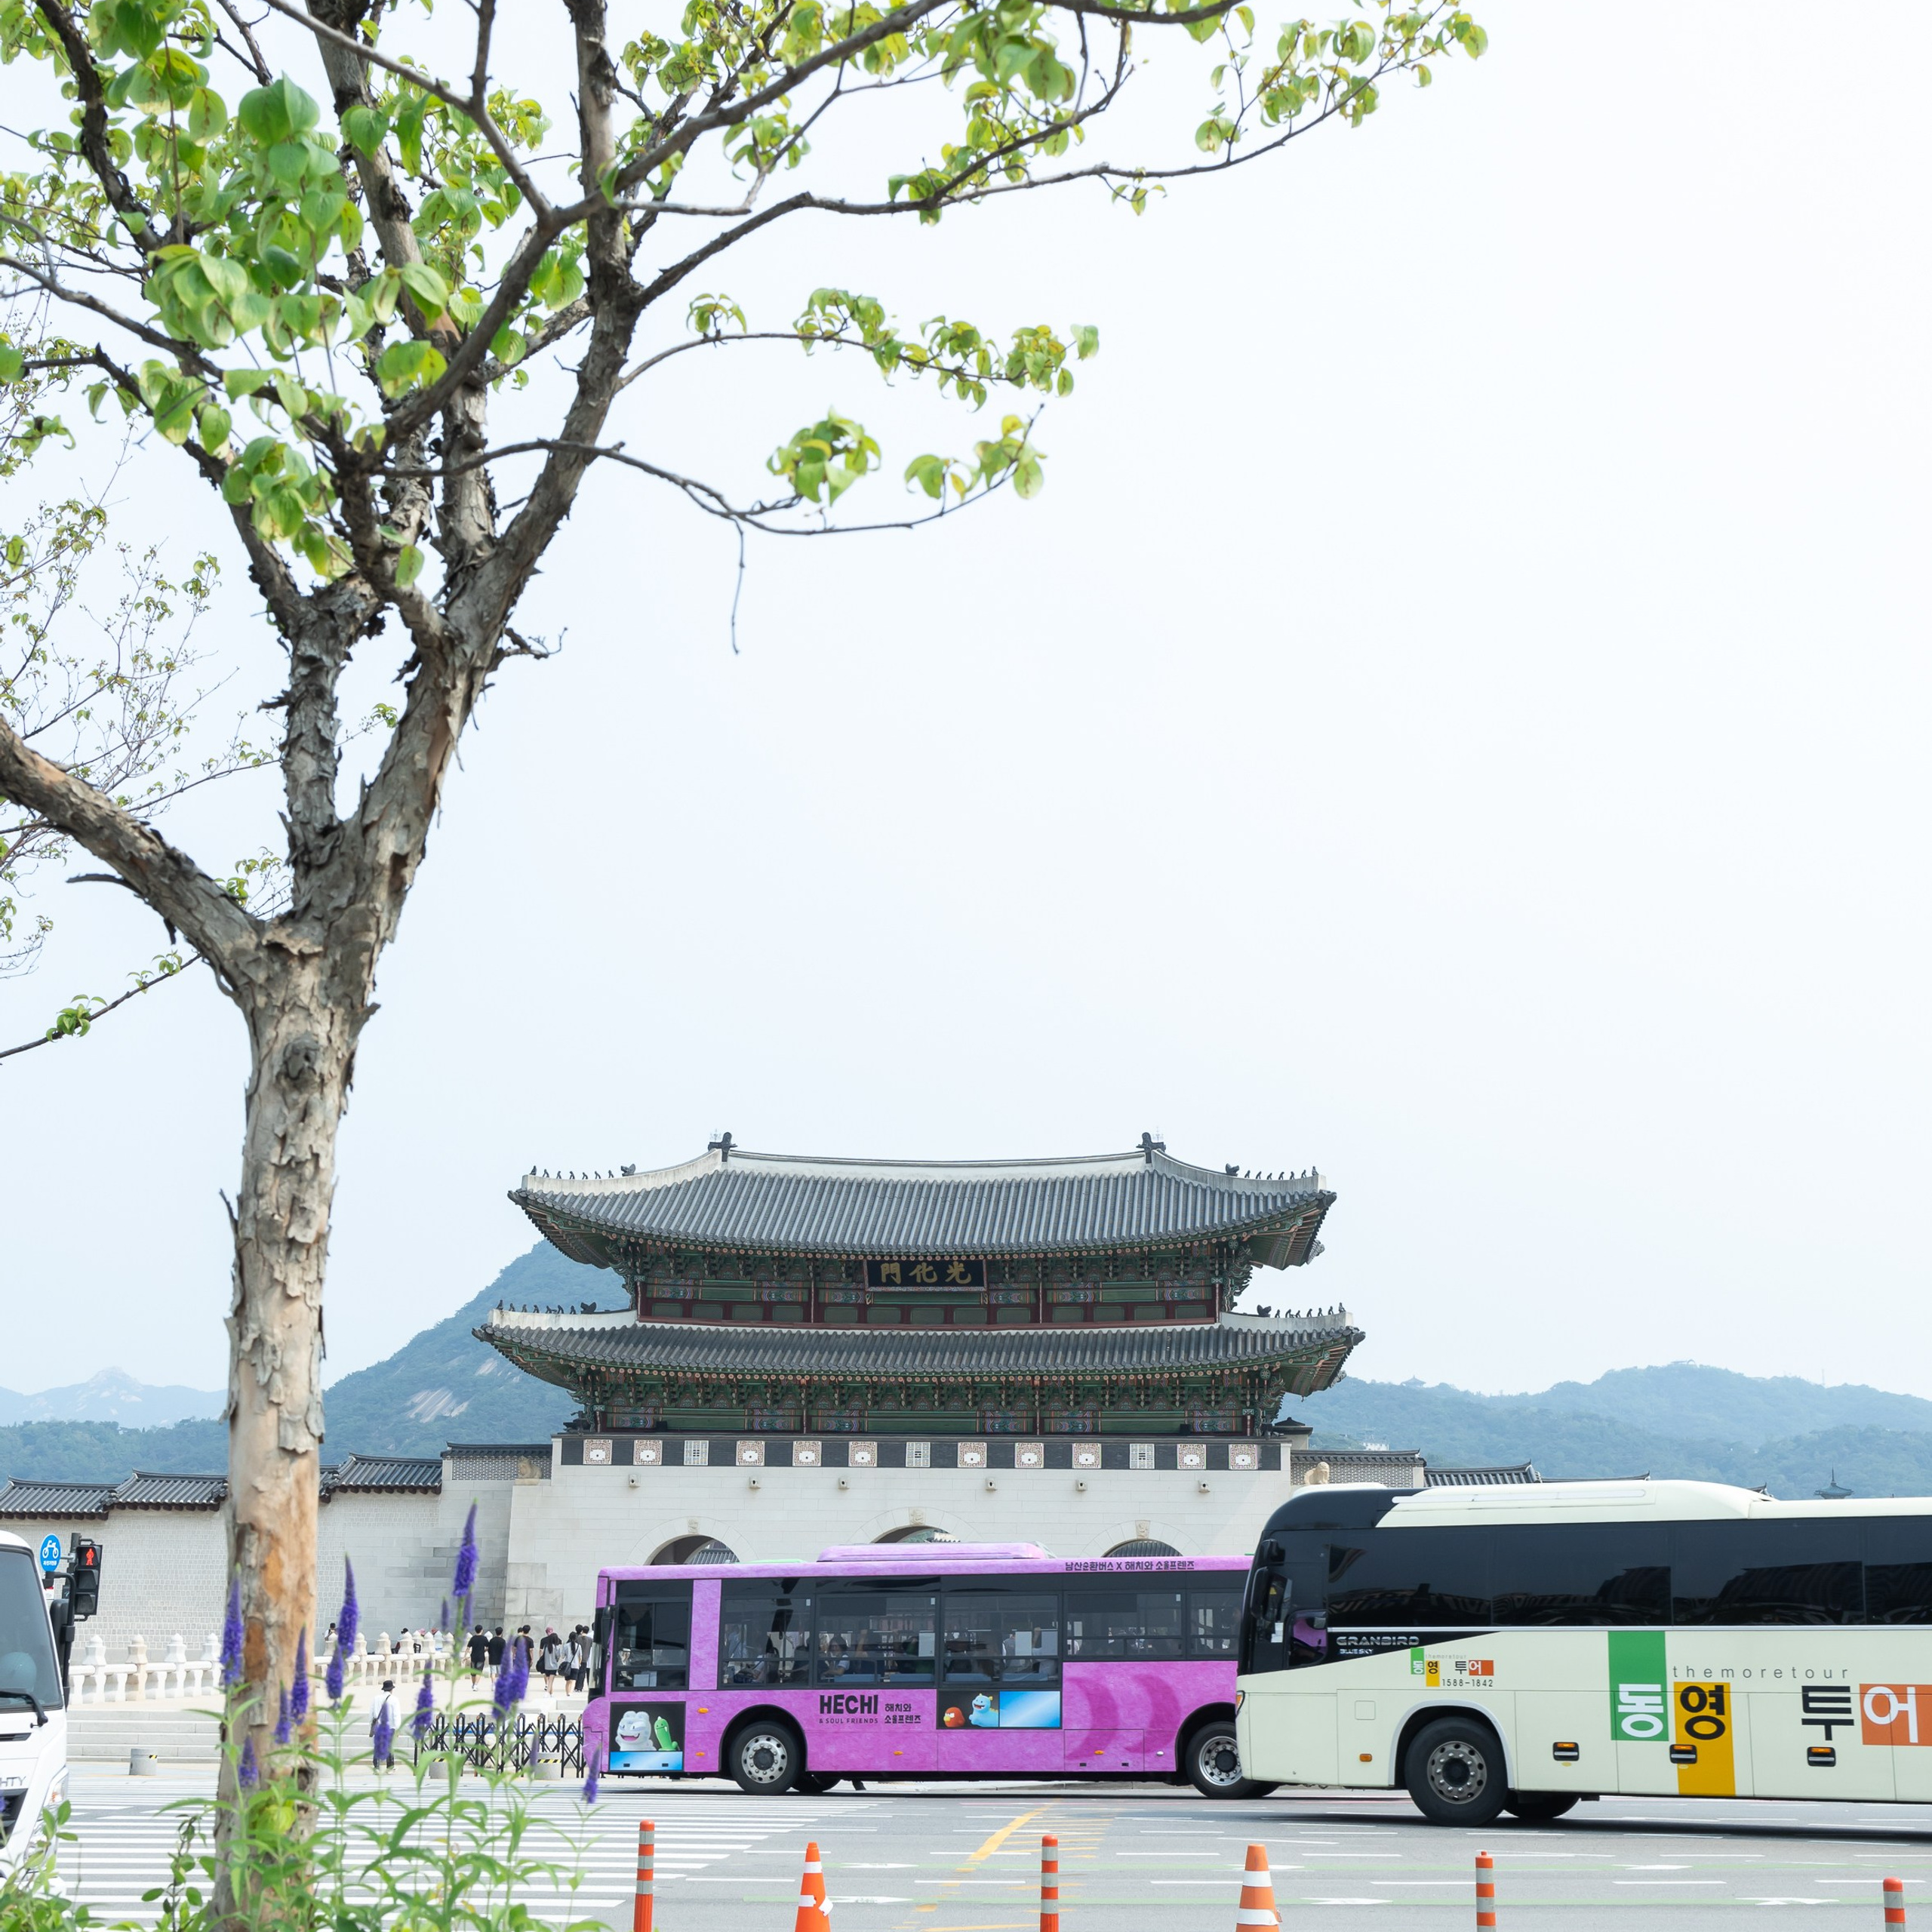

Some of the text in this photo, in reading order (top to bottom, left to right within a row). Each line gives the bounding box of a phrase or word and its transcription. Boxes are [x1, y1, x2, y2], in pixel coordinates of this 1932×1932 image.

[1066, 1561, 1114, 1571] 남산순환버스
[1124, 1561, 1153, 1571] 해치와
[1155, 1560, 1195, 1571] 소울프렌즈
[1336, 1636, 1420, 1645] GRANBIRD
[1672, 1666, 1849, 1679] themoretour
[1442, 1679, 1494, 1687] 1588-1842
[820, 1694, 878, 1714] HECHI
[884, 1703, 912, 1712] 해치와
[884, 1715, 921, 1724] 소울프렌즈
